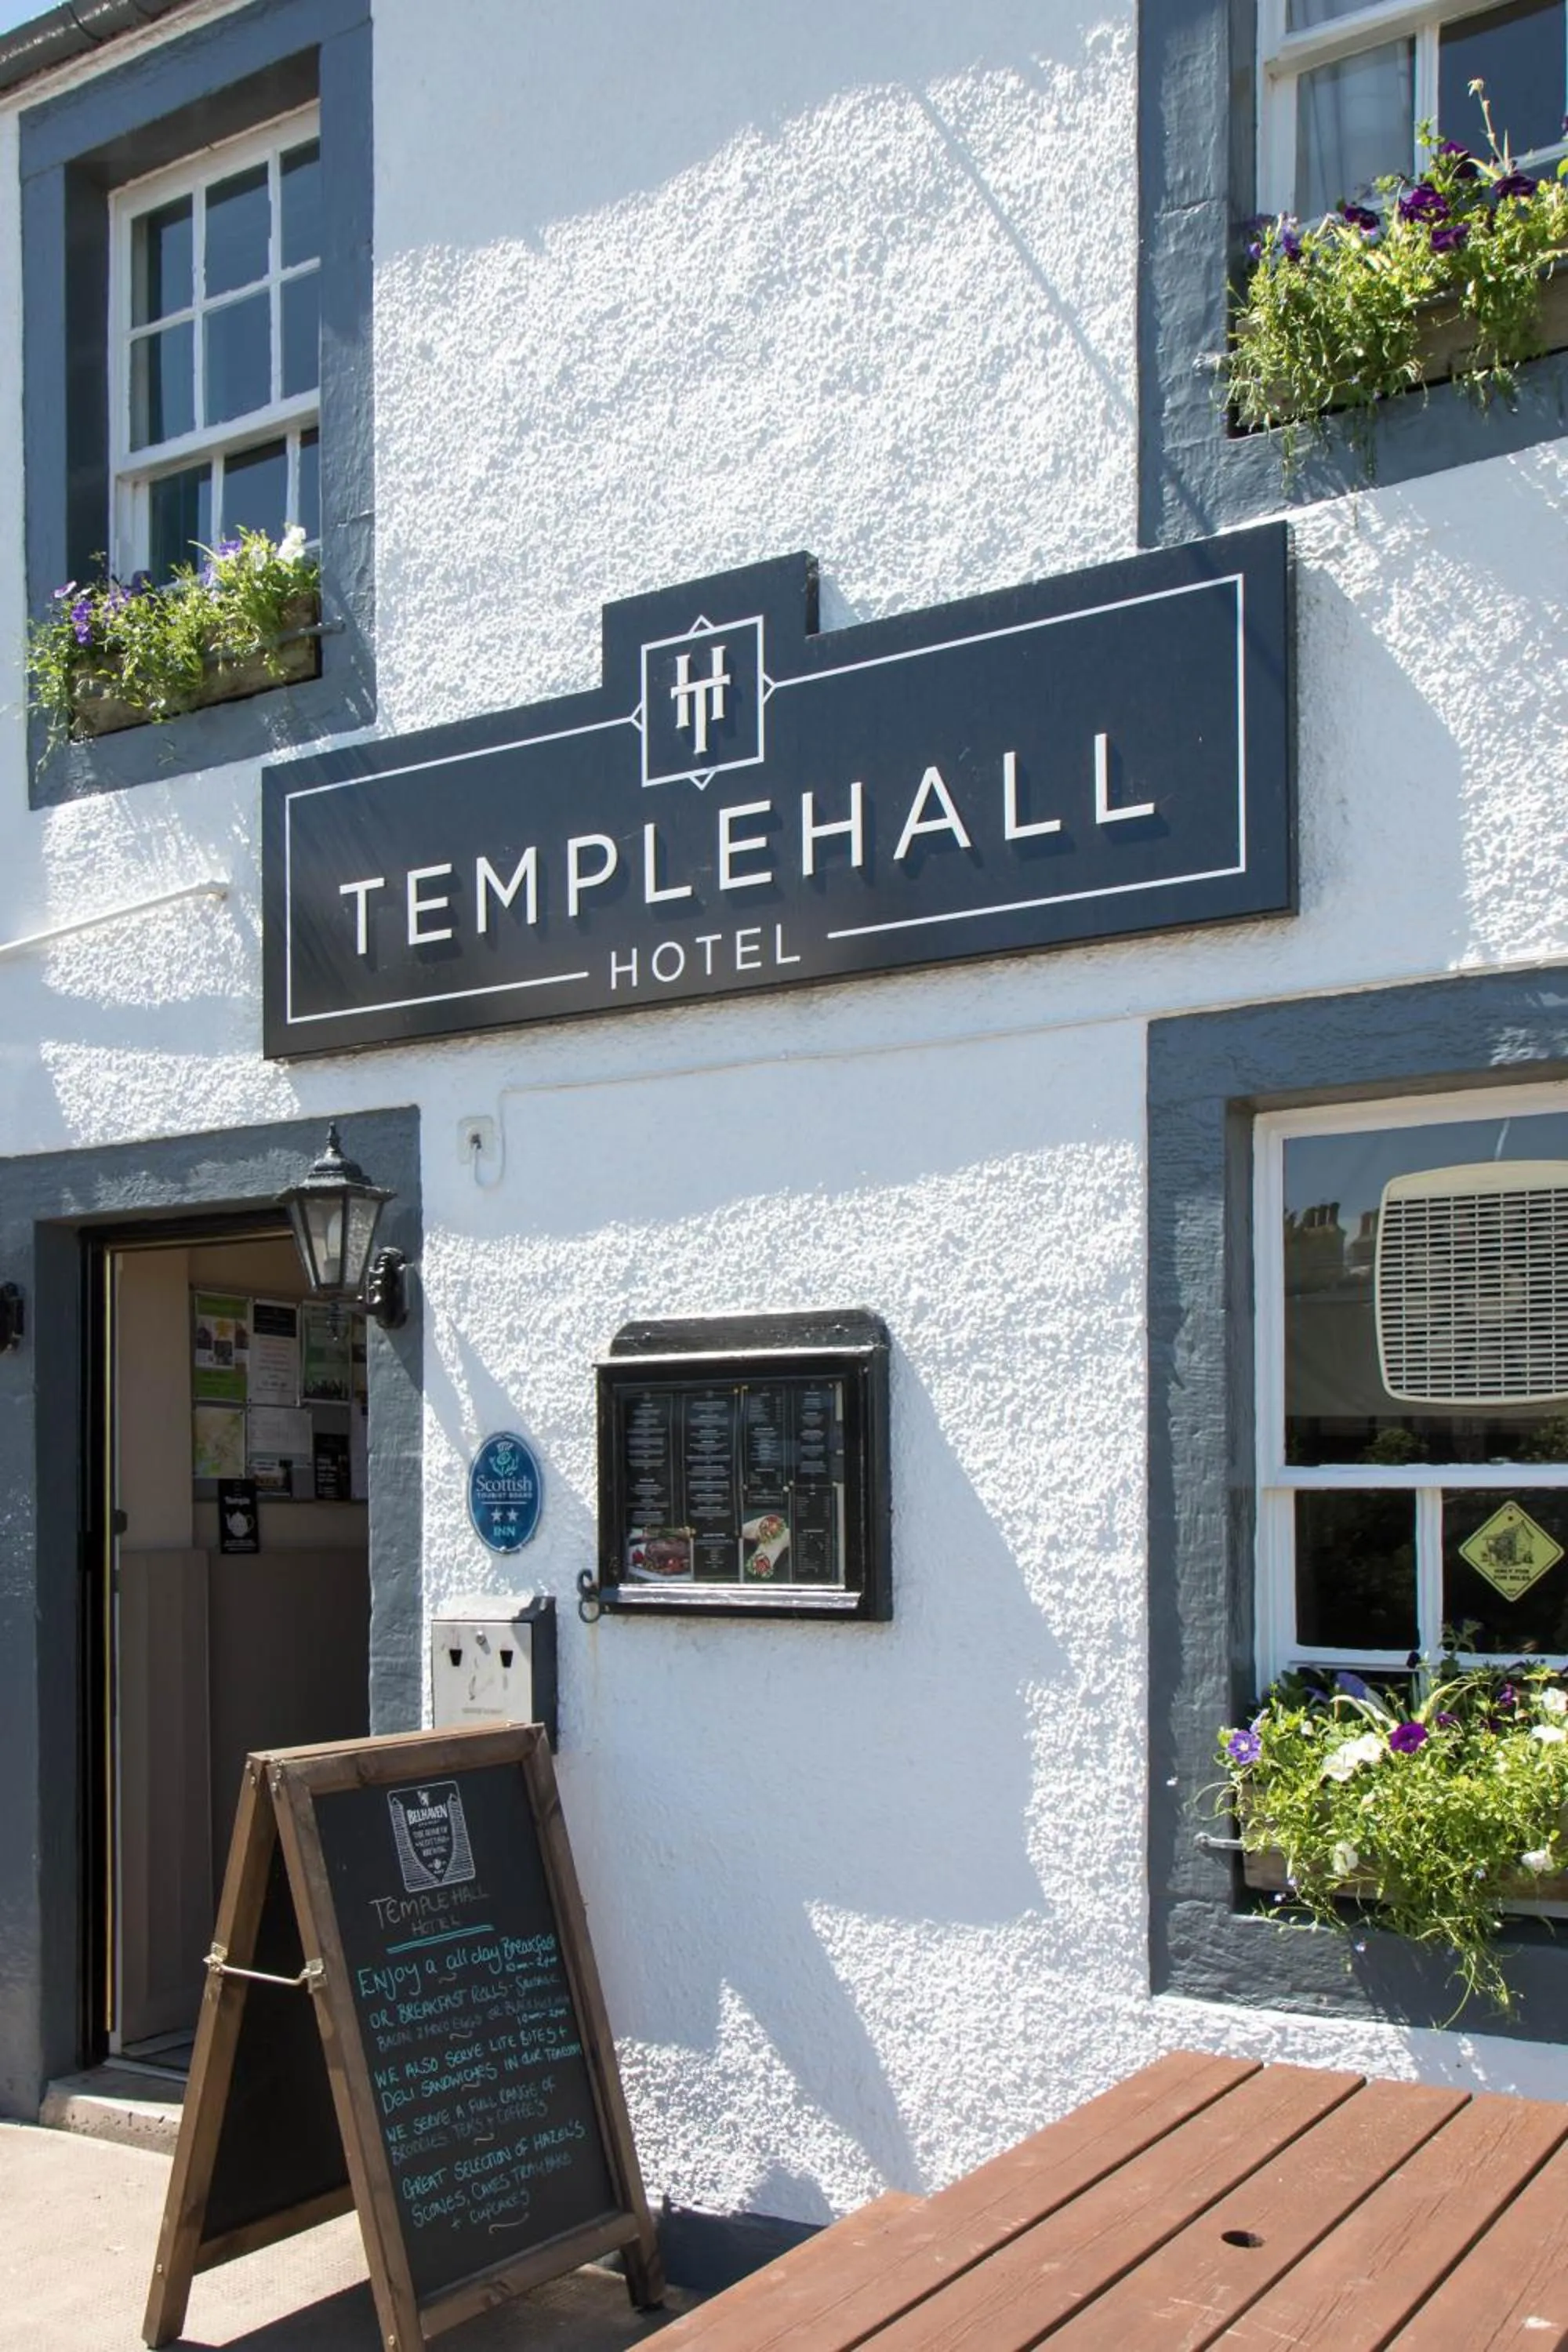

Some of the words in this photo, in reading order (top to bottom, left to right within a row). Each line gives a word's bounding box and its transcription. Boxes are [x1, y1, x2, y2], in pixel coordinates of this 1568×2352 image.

[339, 732, 1156, 955] TEMPLEHALL
[608, 923, 801, 991] HOTEL
[476, 1474, 533, 1492] Scottish
[493, 1525, 516, 1537] INN
[406, 1802, 448, 1825] BELHAVEN
[446, 1948, 468, 1969] all
[471, 1946, 503, 1974] day
[370, 2009, 394, 2029] OR
[397, 1989, 467, 2024] BREAKFAST
[375, 2067, 399, 2089] WE
[405, 2057, 438, 2078] ALSO
[445, 2042, 485, 2068] SERVE
[488, 2035, 517, 2052] LITE
[381, 2087, 416, 2116] DELI
[421, 2062, 499, 2098] SANDWICHES
[504, 2053, 520, 2071] IN
[386, 2123, 408, 2142] WE
[413, 2109, 450, 2136] SERVE
[456, 2104, 466, 2120] A
[402, 2167, 448, 2201] GREAT
[454, 2147, 513, 2181] SELECTION
[514, 2137, 528, 2157] OF
